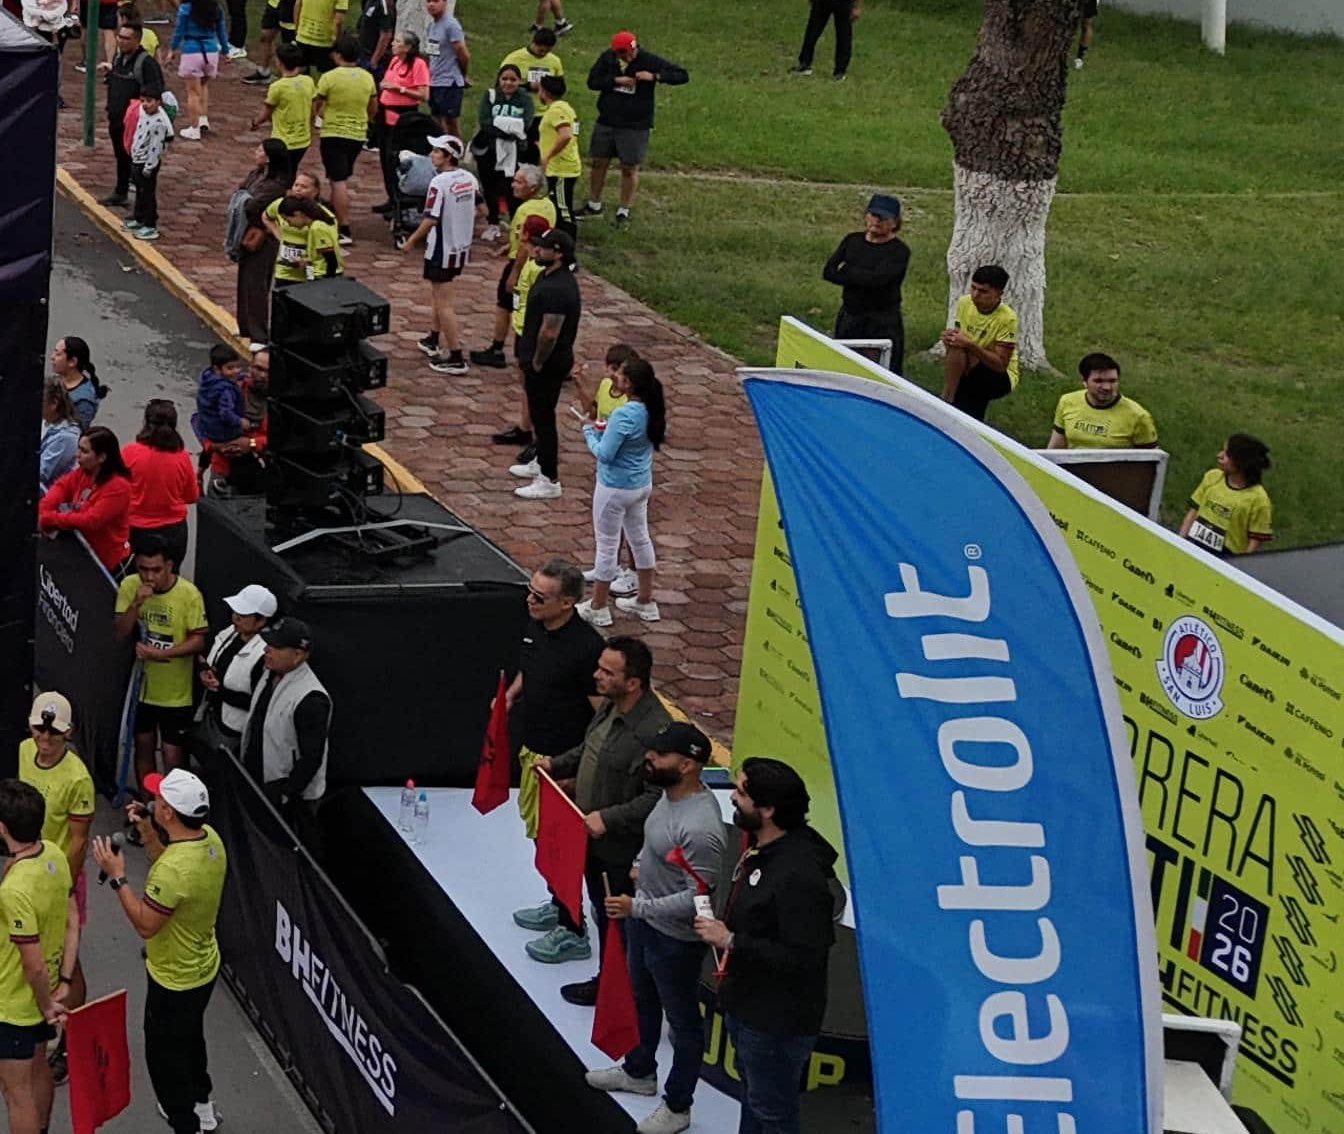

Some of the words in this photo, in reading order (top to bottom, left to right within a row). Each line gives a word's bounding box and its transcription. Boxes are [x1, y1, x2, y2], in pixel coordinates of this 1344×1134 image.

[39, 563, 79, 634] Libertad
[1163, 676, 1180, 703] SAN
[1189, 703, 1212, 716] LUIS
[1218, 894, 1258, 944] 20
[1211, 932, 1252, 983] 26
[275, 900, 399, 1116] BHFITNESS
